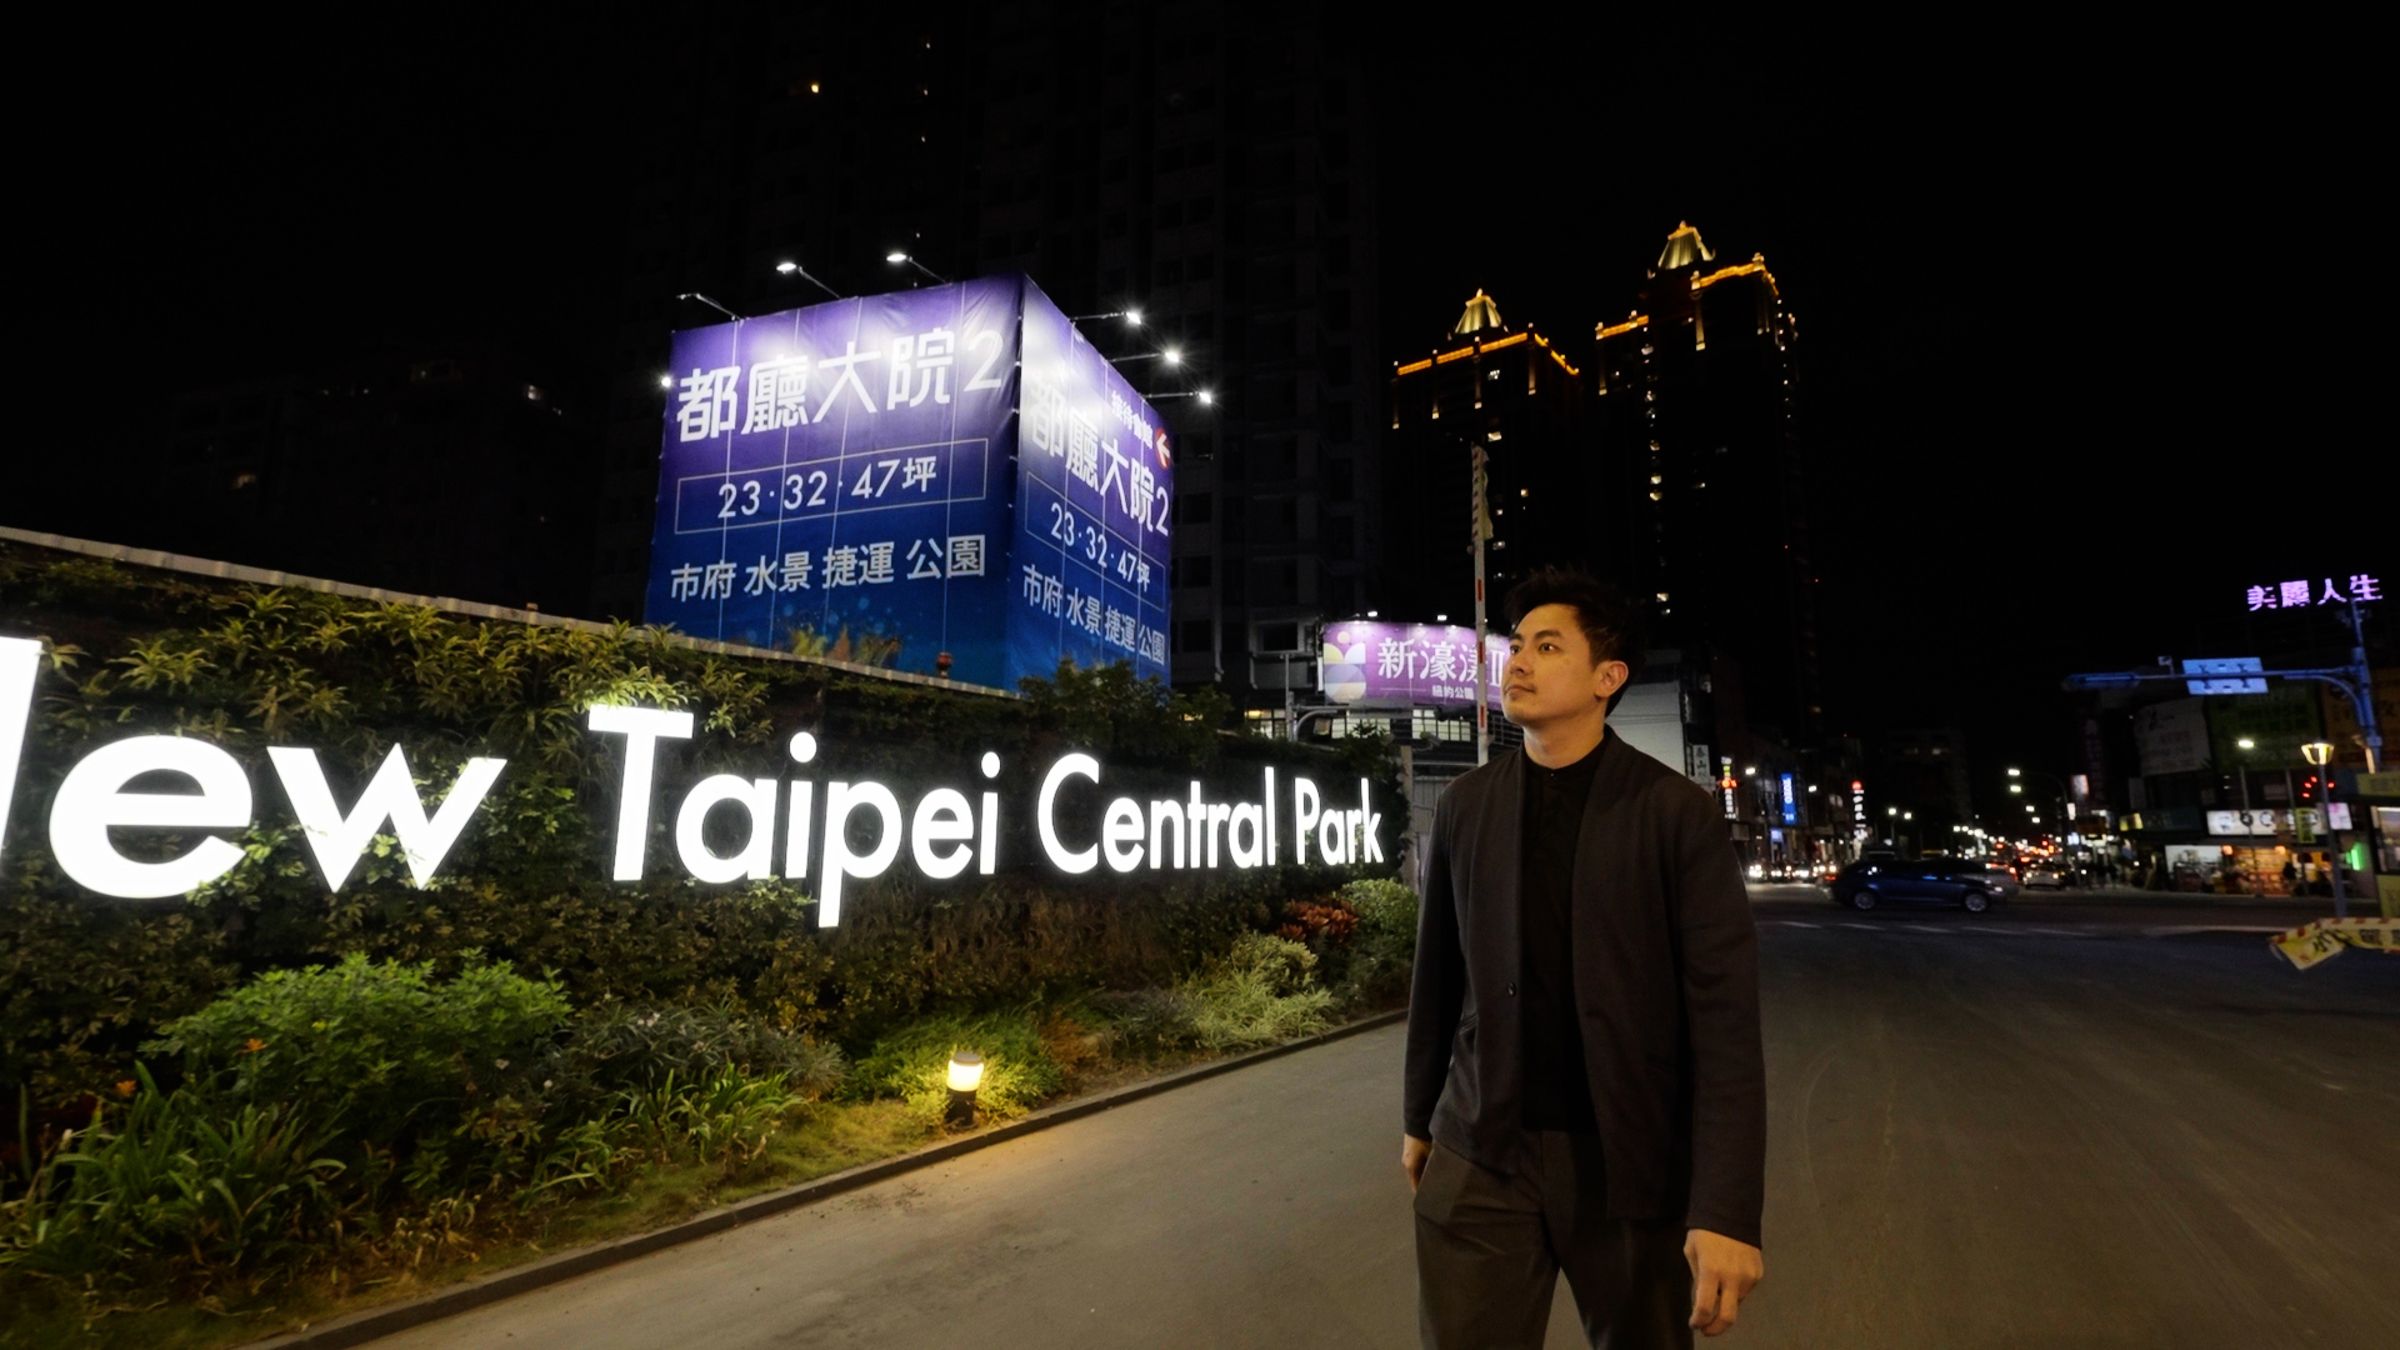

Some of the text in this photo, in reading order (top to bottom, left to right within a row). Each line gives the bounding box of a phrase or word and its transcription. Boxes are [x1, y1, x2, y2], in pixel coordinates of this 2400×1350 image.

[676, 327, 1004, 442] 都廳大院2
[1030, 384, 1169, 537] 都廳大院2
[670, 534, 986, 602] 市府 水景 捷運 公園
[1022, 563, 1064, 619] 市府
[1066, 587, 1101, 636] 水景
[588, 704, 1001, 928] Taipei
[1037, 752, 1275, 873] Central
[1295, 777, 1384, 865] Park
